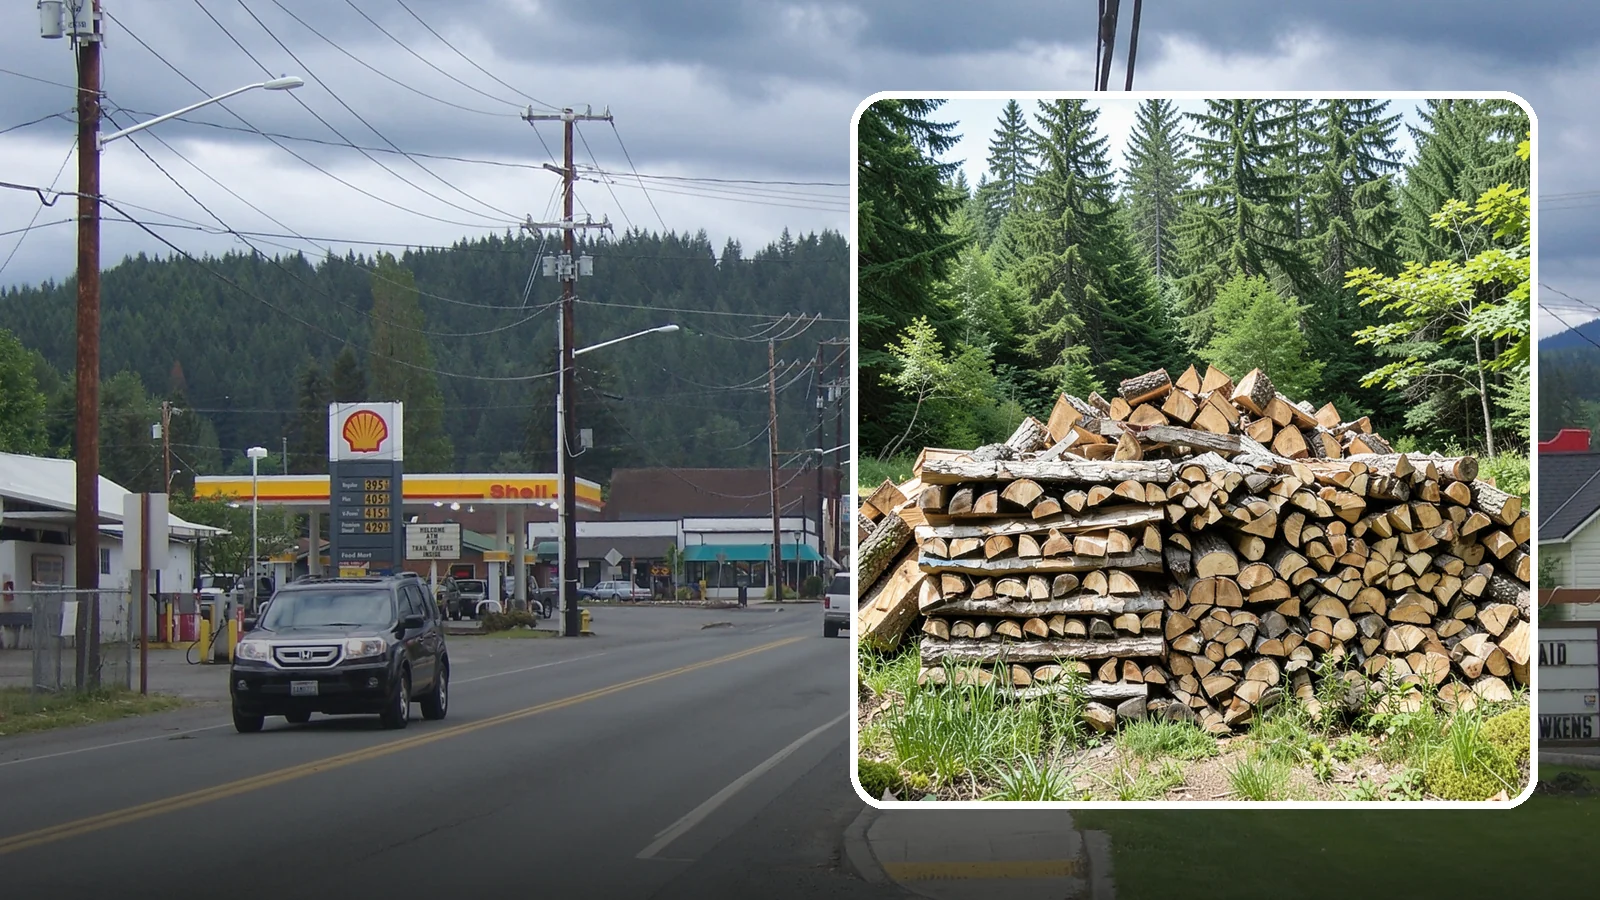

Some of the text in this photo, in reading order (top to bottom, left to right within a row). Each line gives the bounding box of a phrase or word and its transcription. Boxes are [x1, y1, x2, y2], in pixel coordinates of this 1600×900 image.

[366, 480, 383, 490] 395
[490, 484, 547, 499] Shell
[366, 494, 383, 504] 405
[366, 508, 383, 518] 415
[366, 522, 383, 532] 429
